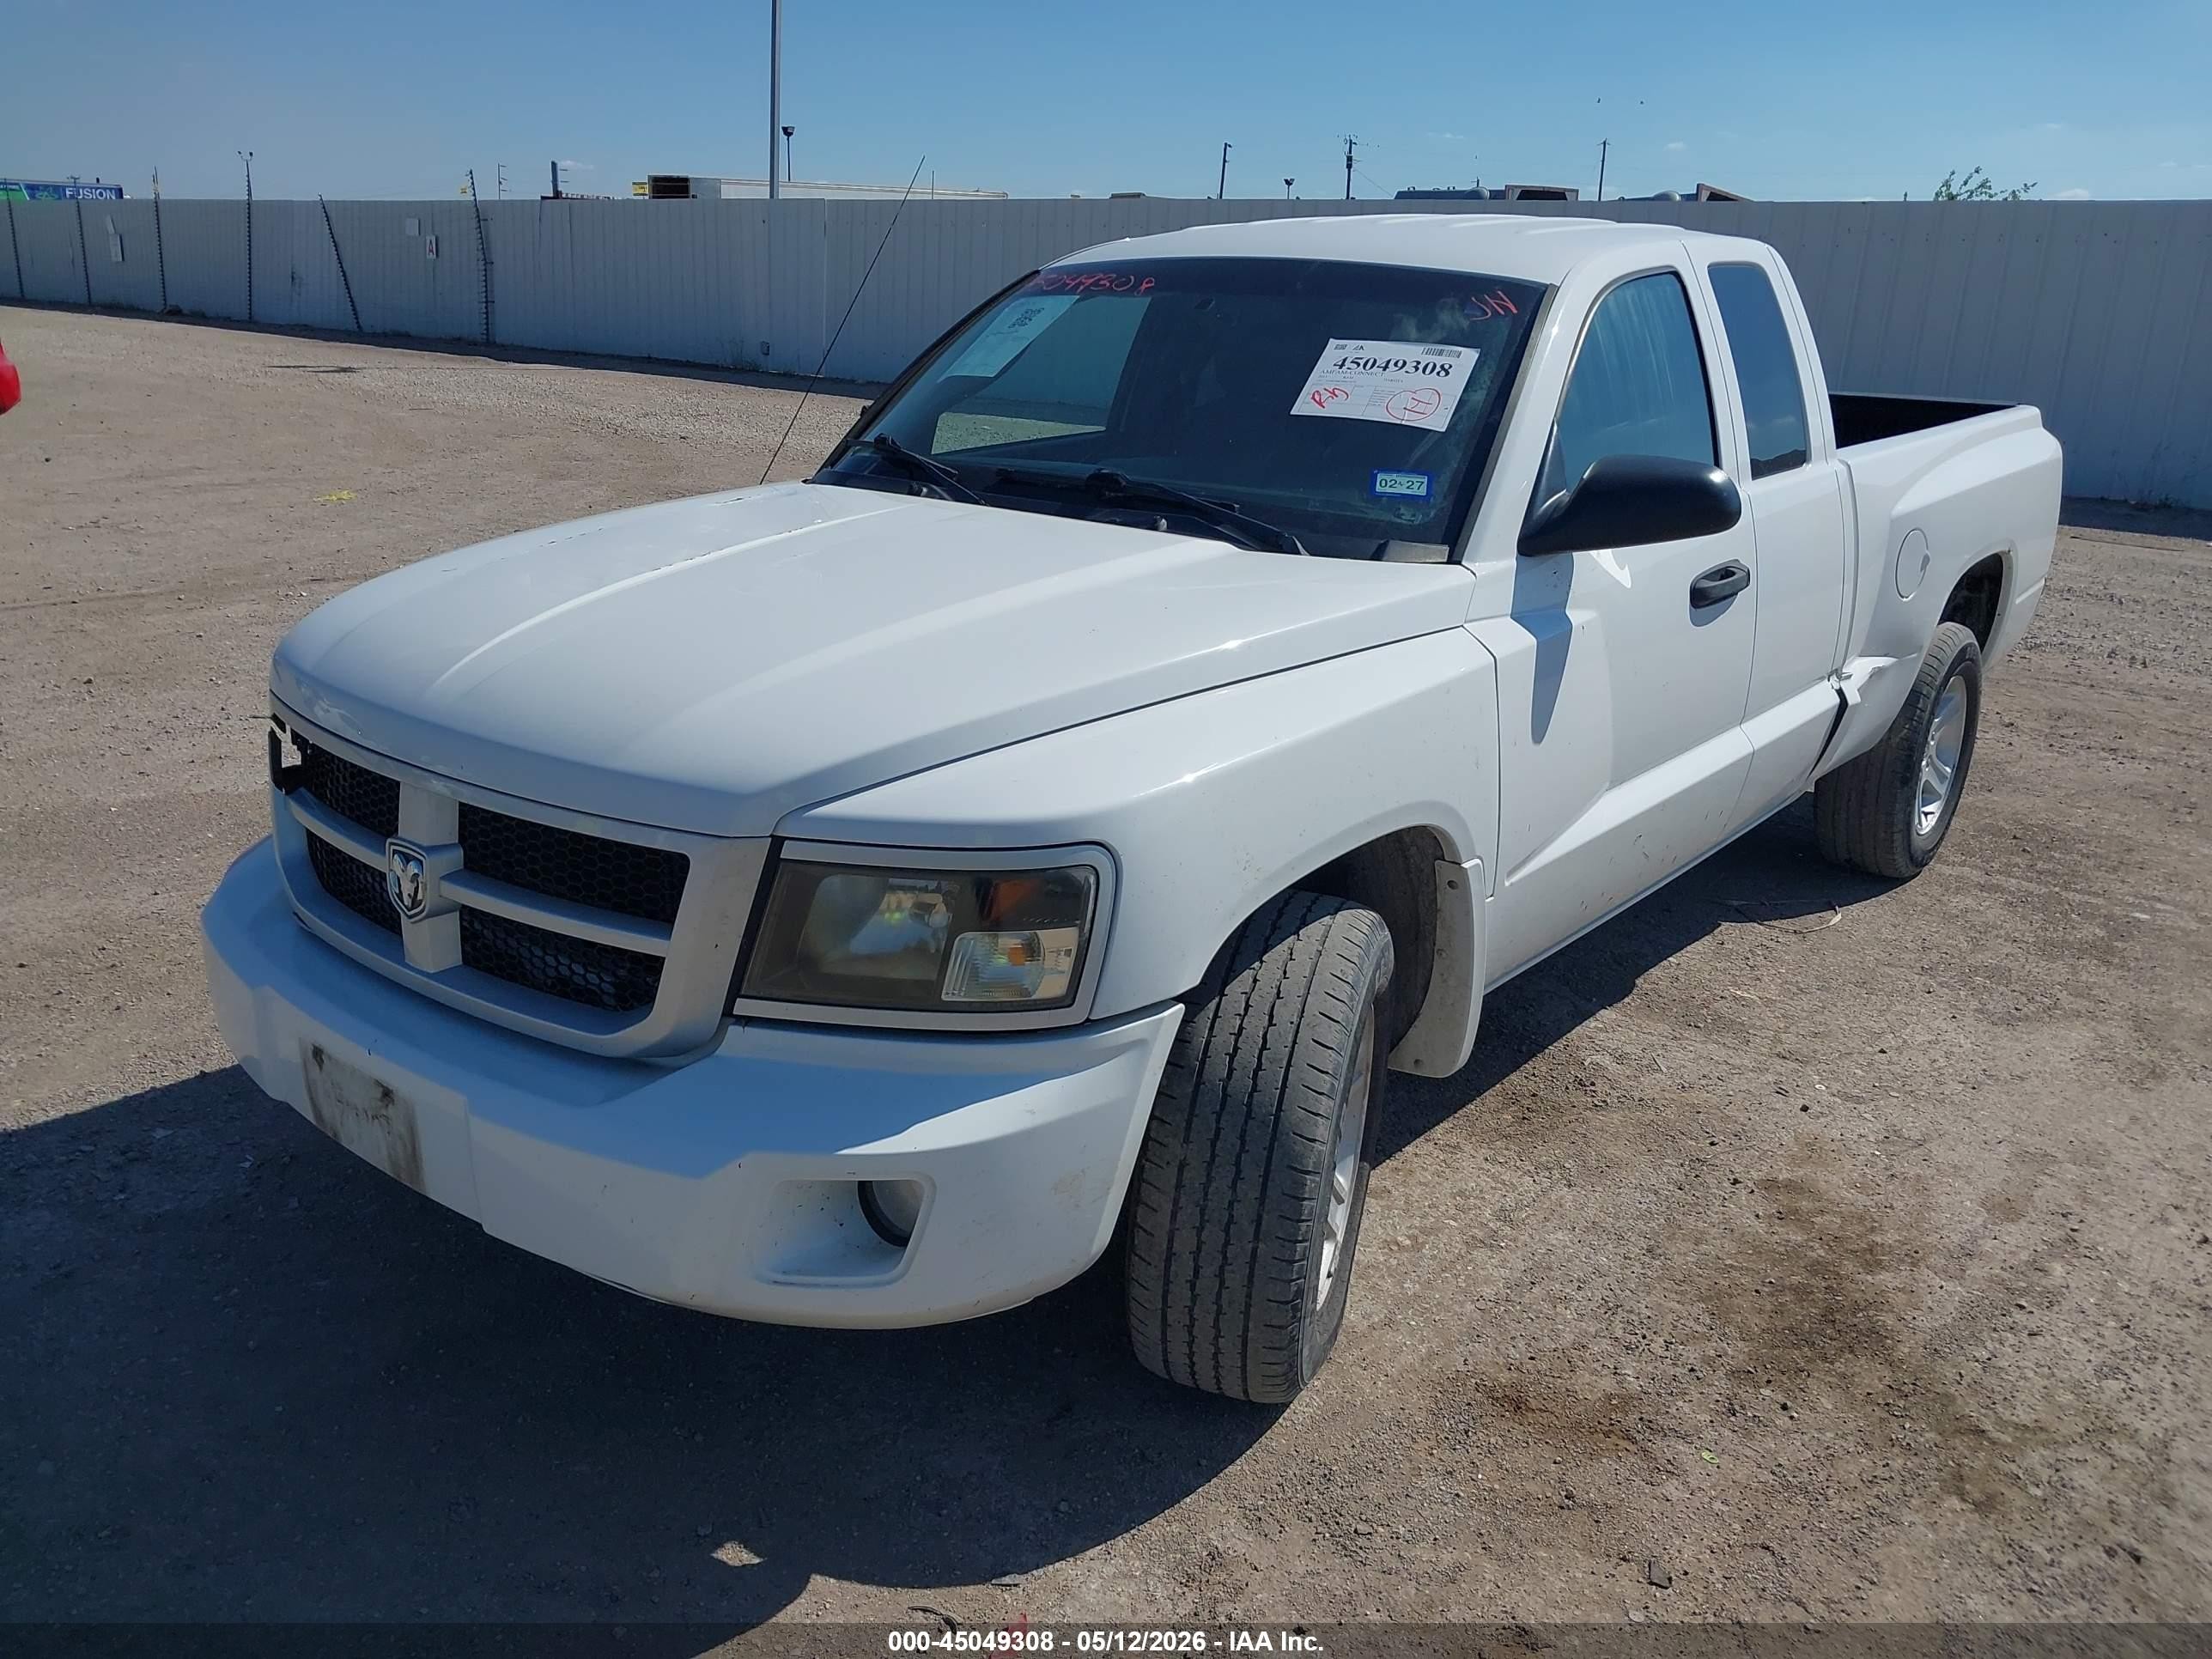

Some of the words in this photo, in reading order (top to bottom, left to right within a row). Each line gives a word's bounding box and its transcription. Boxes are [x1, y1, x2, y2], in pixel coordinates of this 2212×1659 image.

[65, 187, 116, 199] FUSION
[428, 240, 434, 255] A
[1334, 356, 1453, 378] 45049308
